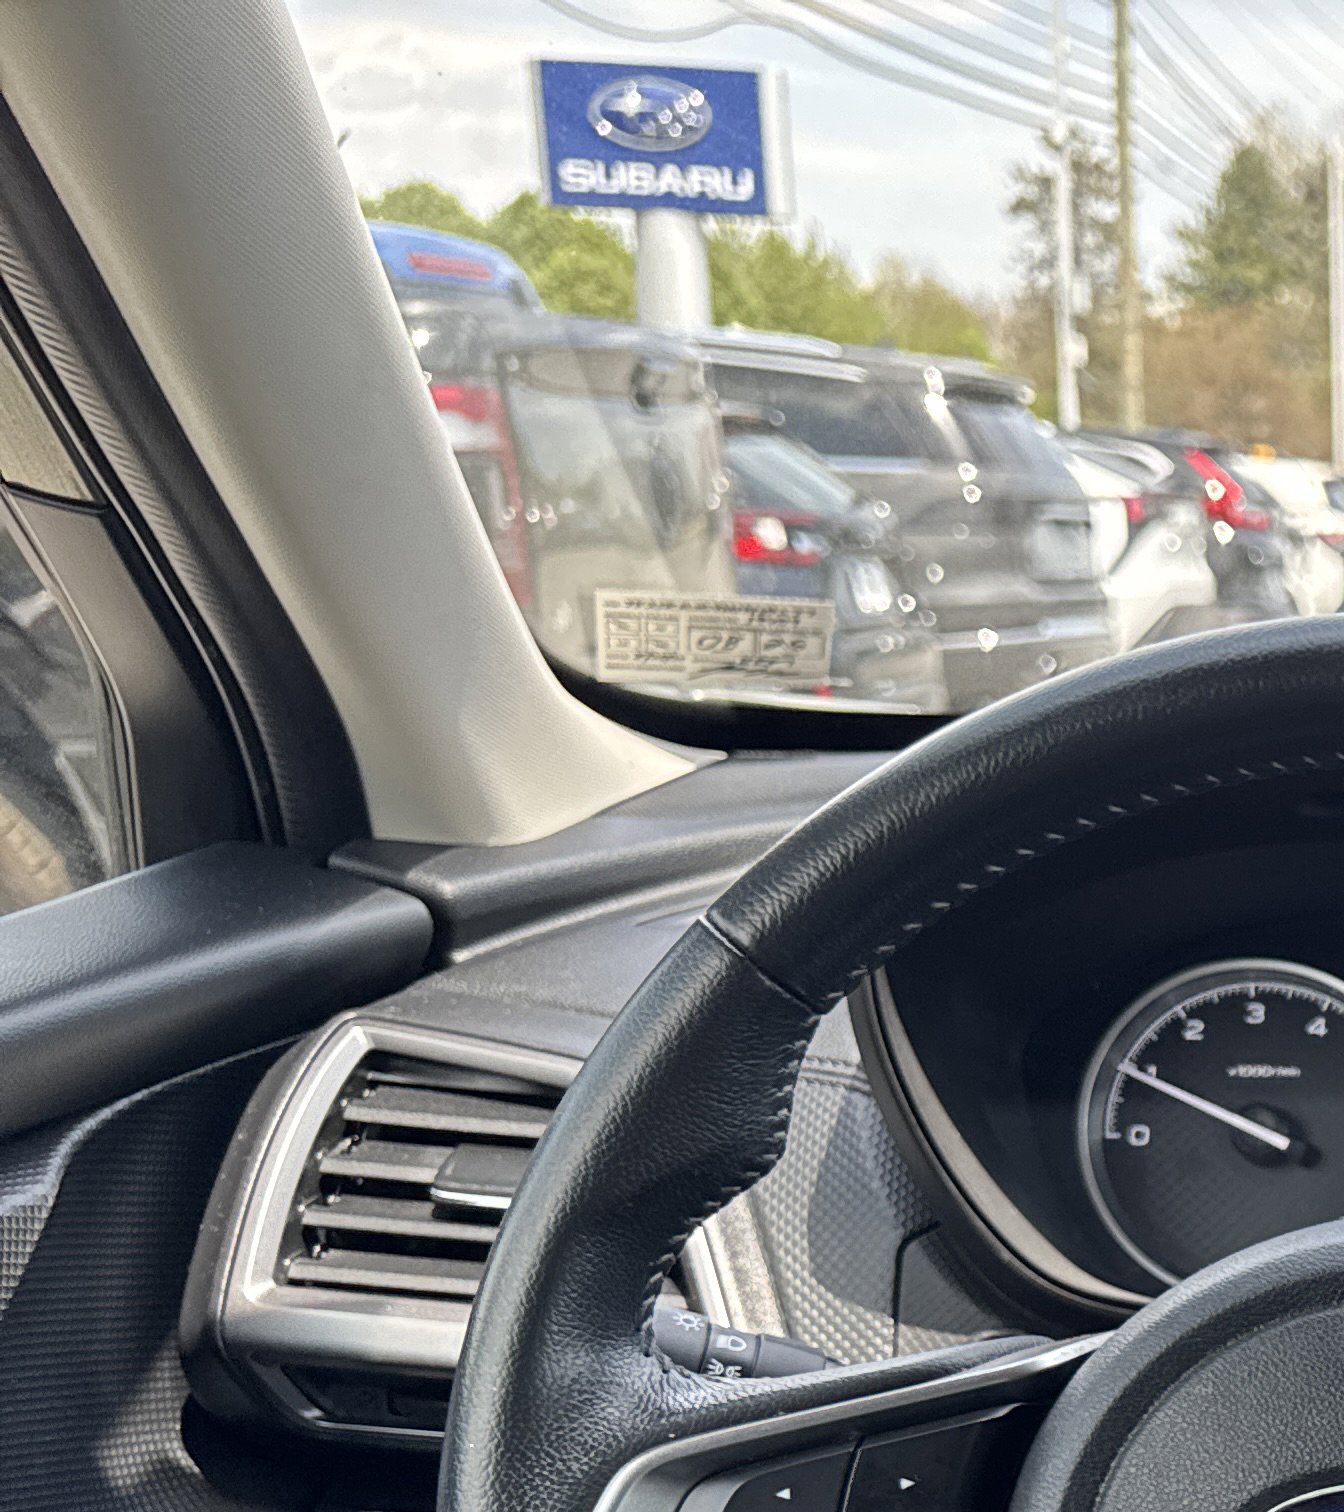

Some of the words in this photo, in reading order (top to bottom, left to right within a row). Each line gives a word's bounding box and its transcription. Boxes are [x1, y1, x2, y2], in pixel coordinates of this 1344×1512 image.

[557, 158, 755, 201] SUBARU
[1245, 1003, 1266, 1024] 3
[1183, 1019, 1205, 1040] 2
[1306, 1016, 1328, 1037] 4
[1129, 1124, 1151, 1147] 0
